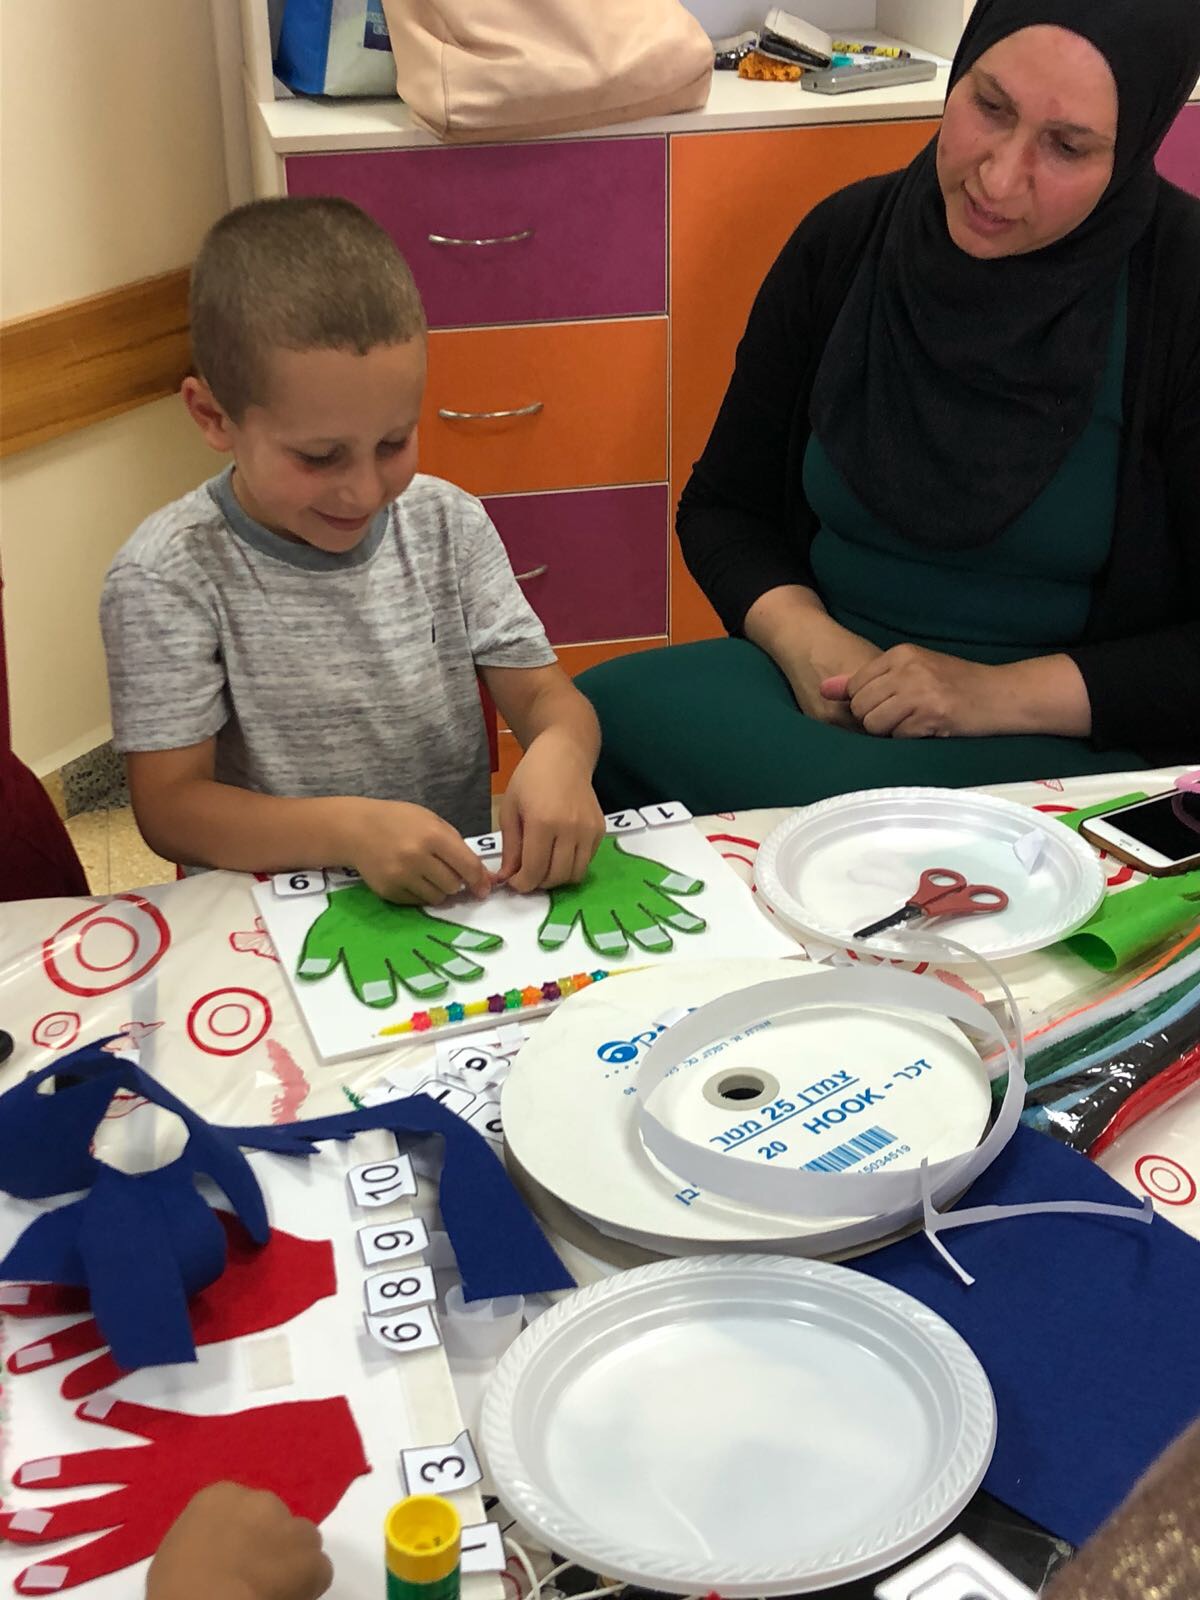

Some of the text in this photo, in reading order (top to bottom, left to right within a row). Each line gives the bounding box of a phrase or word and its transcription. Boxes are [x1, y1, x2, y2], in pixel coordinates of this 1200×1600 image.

[608, 813, 631, 828] 2
[657, 806, 675, 819] 1
[477, 837, 496, 851] 5
[893, 1058, 933, 1081] זכר
[709, 1069, 854, 1147] צמדן 25 מטר
[803, 1087, 886, 1135] HOOK
[758, 1140, 788, 1160] 20
[361, 1164, 403, 1201] 10
[374, 1230, 414, 1250] 9
[380, 1277, 421, 1298] 8
[380, 1322, 422, 1343] 6
[420, 1455, 466, 1483] 3
